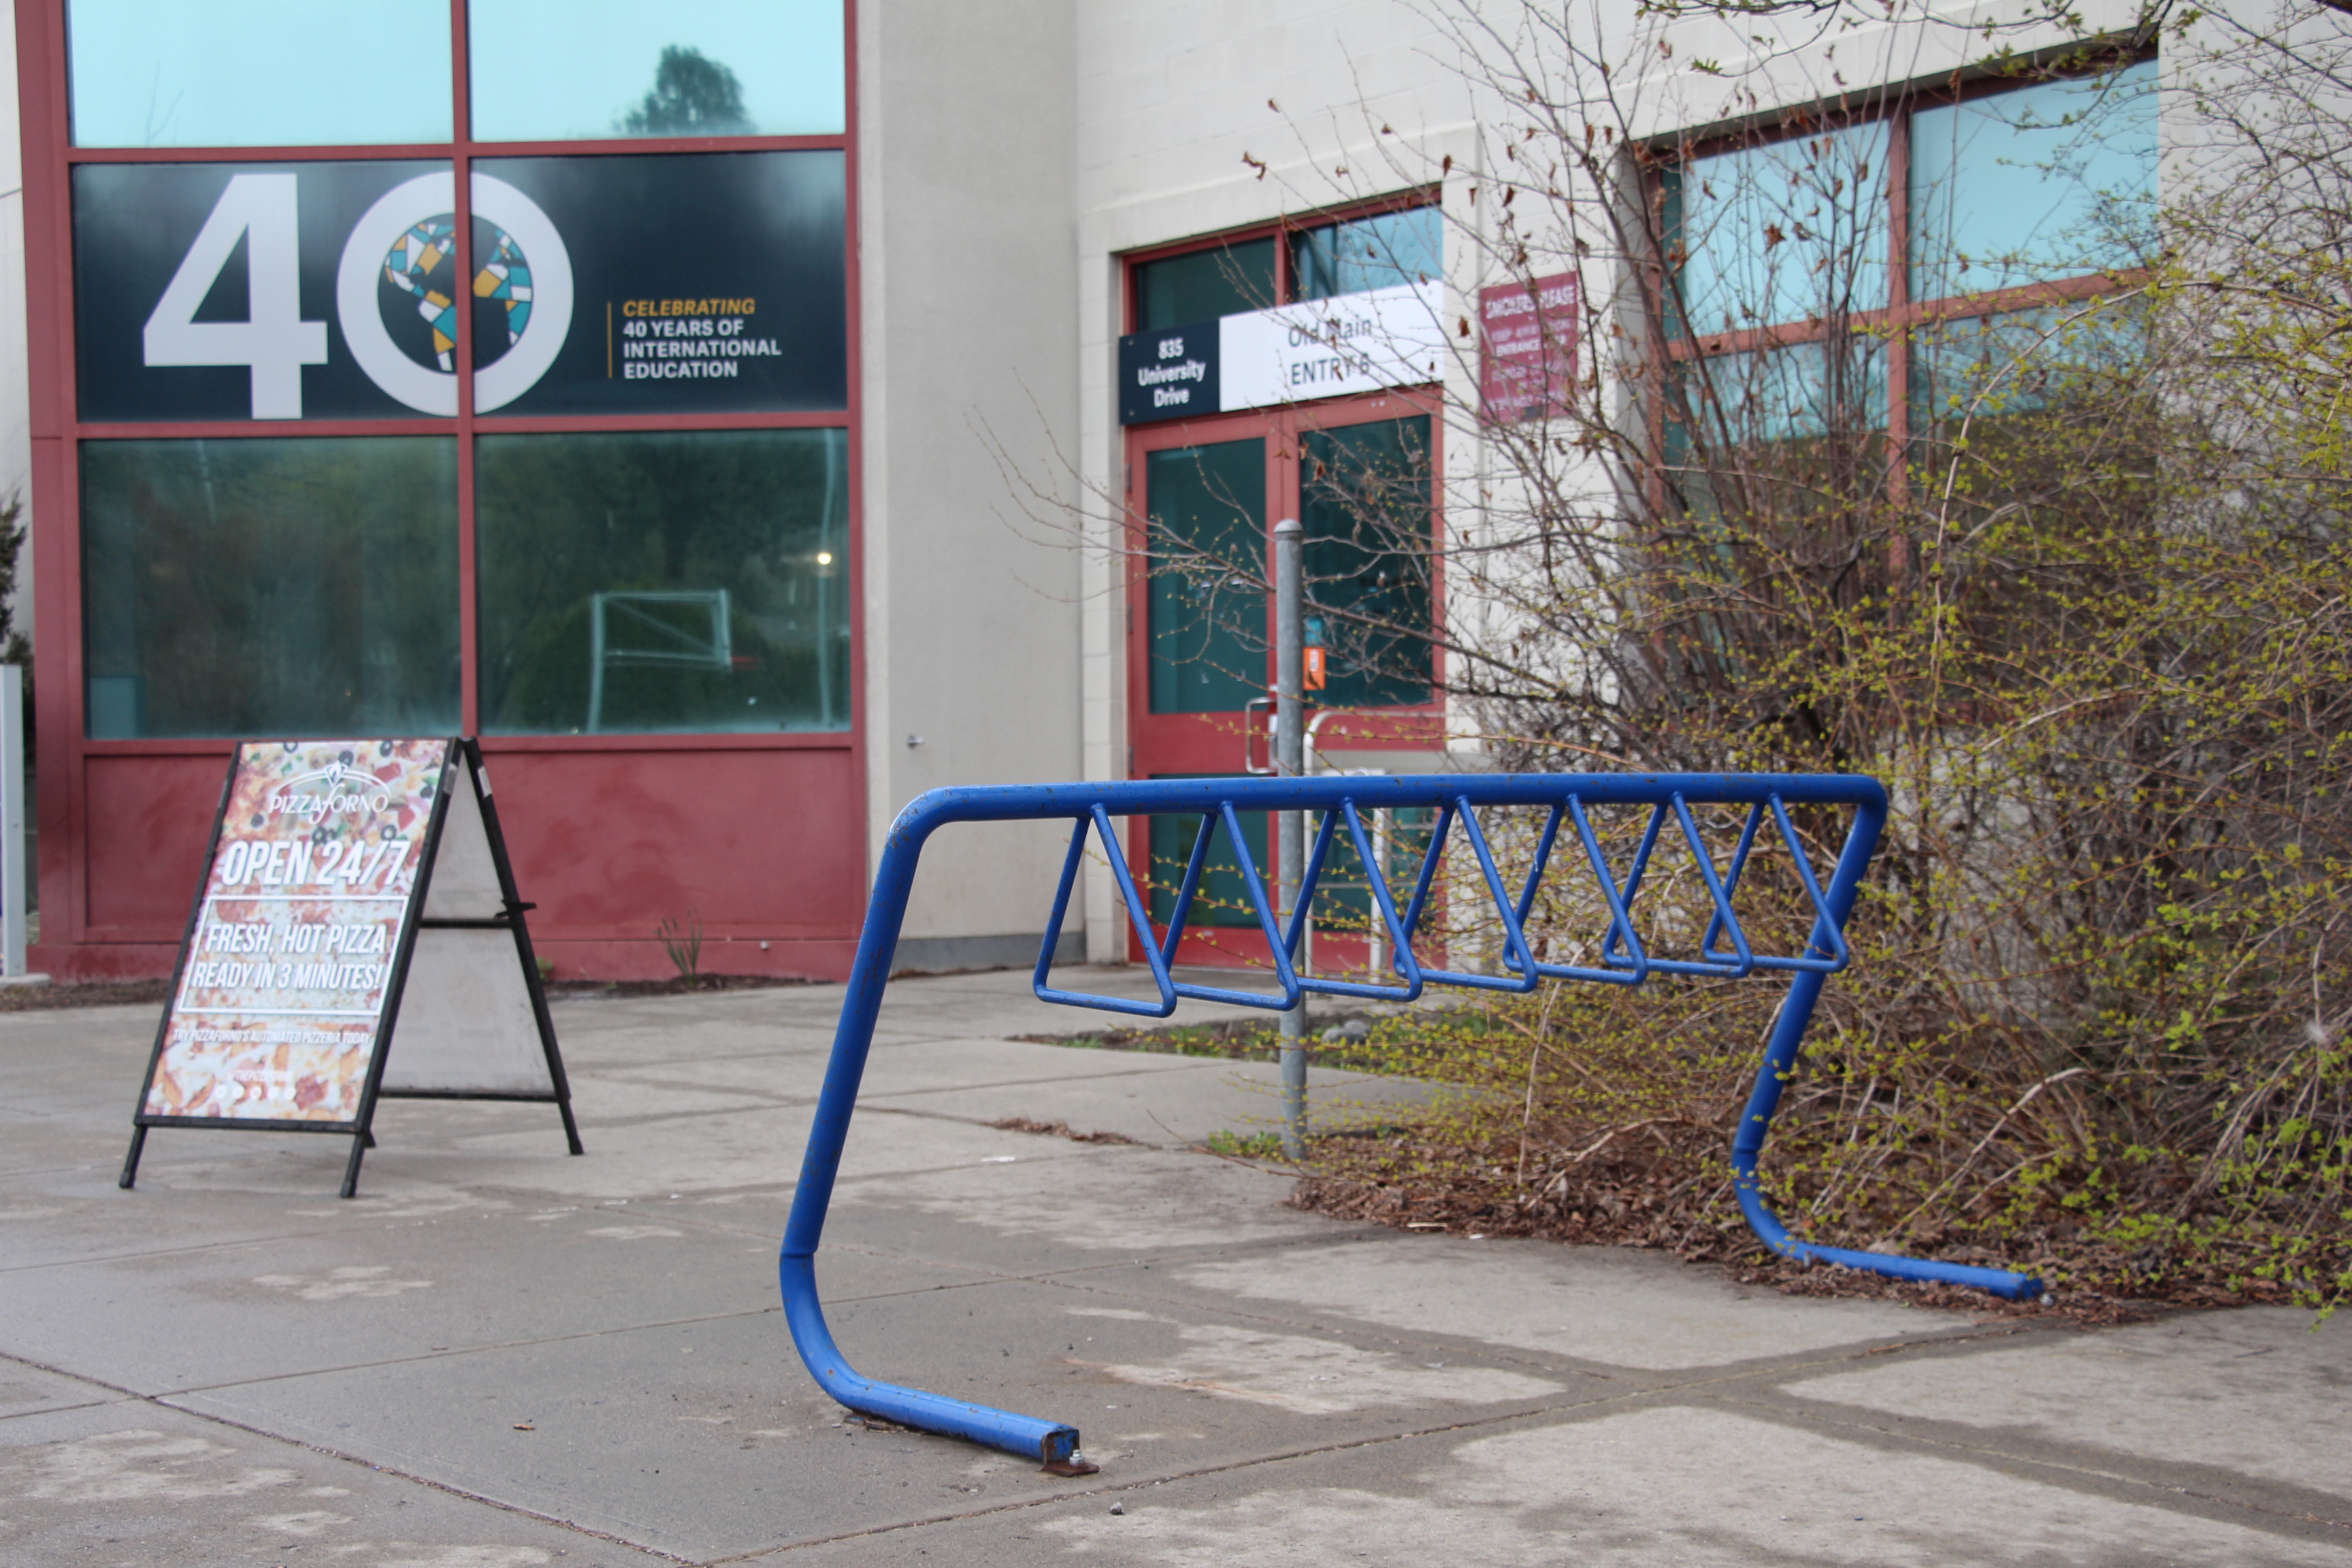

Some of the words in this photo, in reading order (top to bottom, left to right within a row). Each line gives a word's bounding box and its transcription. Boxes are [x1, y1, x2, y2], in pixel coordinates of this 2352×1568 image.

[144, 172, 574, 420] 40
[623, 298, 755, 316] CELEBRATING
[623, 321, 647, 337] 40
[651, 319, 713, 337] YEARS
[717, 318, 744, 336] OF
[1288, 321, 1319, 347] Old
[623, 339, 782, 358] INTERNATIONAL
[1158, 337, 1183, 359] 835
[624, 360, 738, 379] EDUCATION
[1138, 359, 1206, 387] University
[1154, 386, 1190, 408] Drive
[221, 840, 314, 885] OPEN
[316, 840, 411, 885] 24/7
[280, 924, 326, 953] HOT
[327, 924, 387, 953] PIZZA
[193, 962, 255, 987] READY
[255, 962, 276, 987] IN
[278, 963, 292, 988] 3
[293, 963, 385, 990] MINUTES!
[174, 1029, 191, 1041] TRY
[250, 1030, 301, 1043] AUTOMATED
[302, 1030, 341, 1043] PIZZERIA
